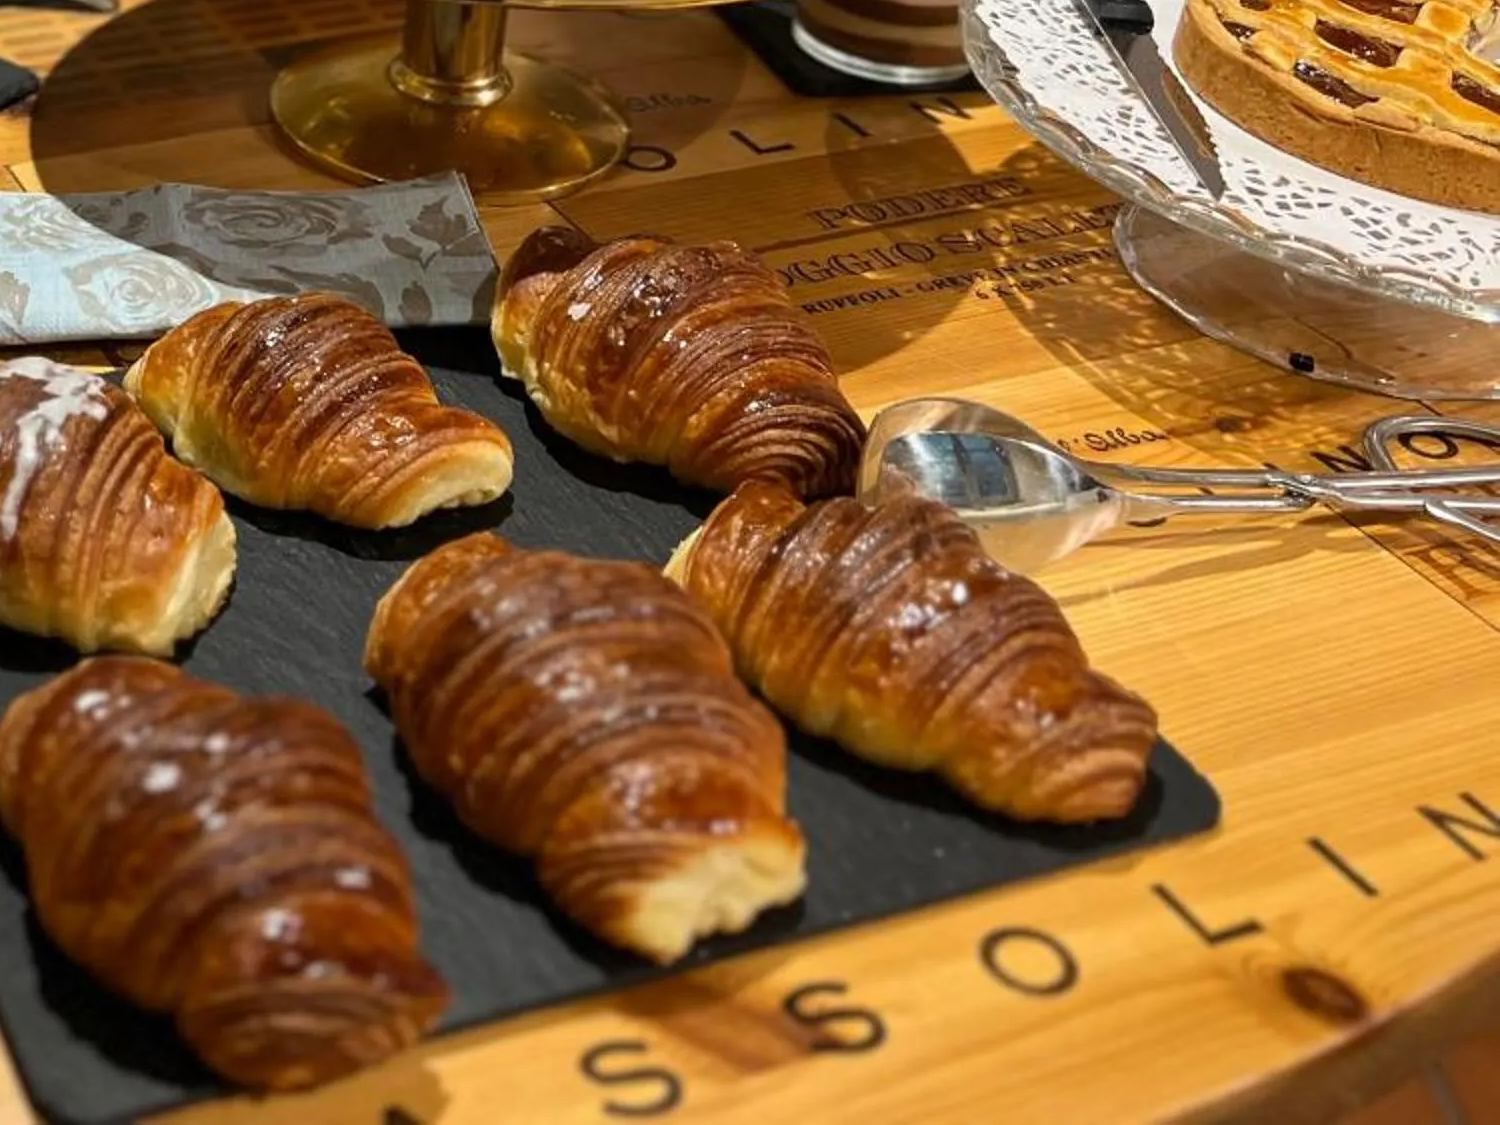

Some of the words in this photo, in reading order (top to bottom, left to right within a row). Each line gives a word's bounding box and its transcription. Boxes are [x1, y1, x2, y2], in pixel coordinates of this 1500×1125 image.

[807, 176, 1034, 231] PODERE
[779, 241, 936, 287] GGIO
[801, 287, 901, 315] RUFFOLI
[1021, 247, 1114, 273] CHIANTI
[384, 791, 1500, 1125] SSOLIN
